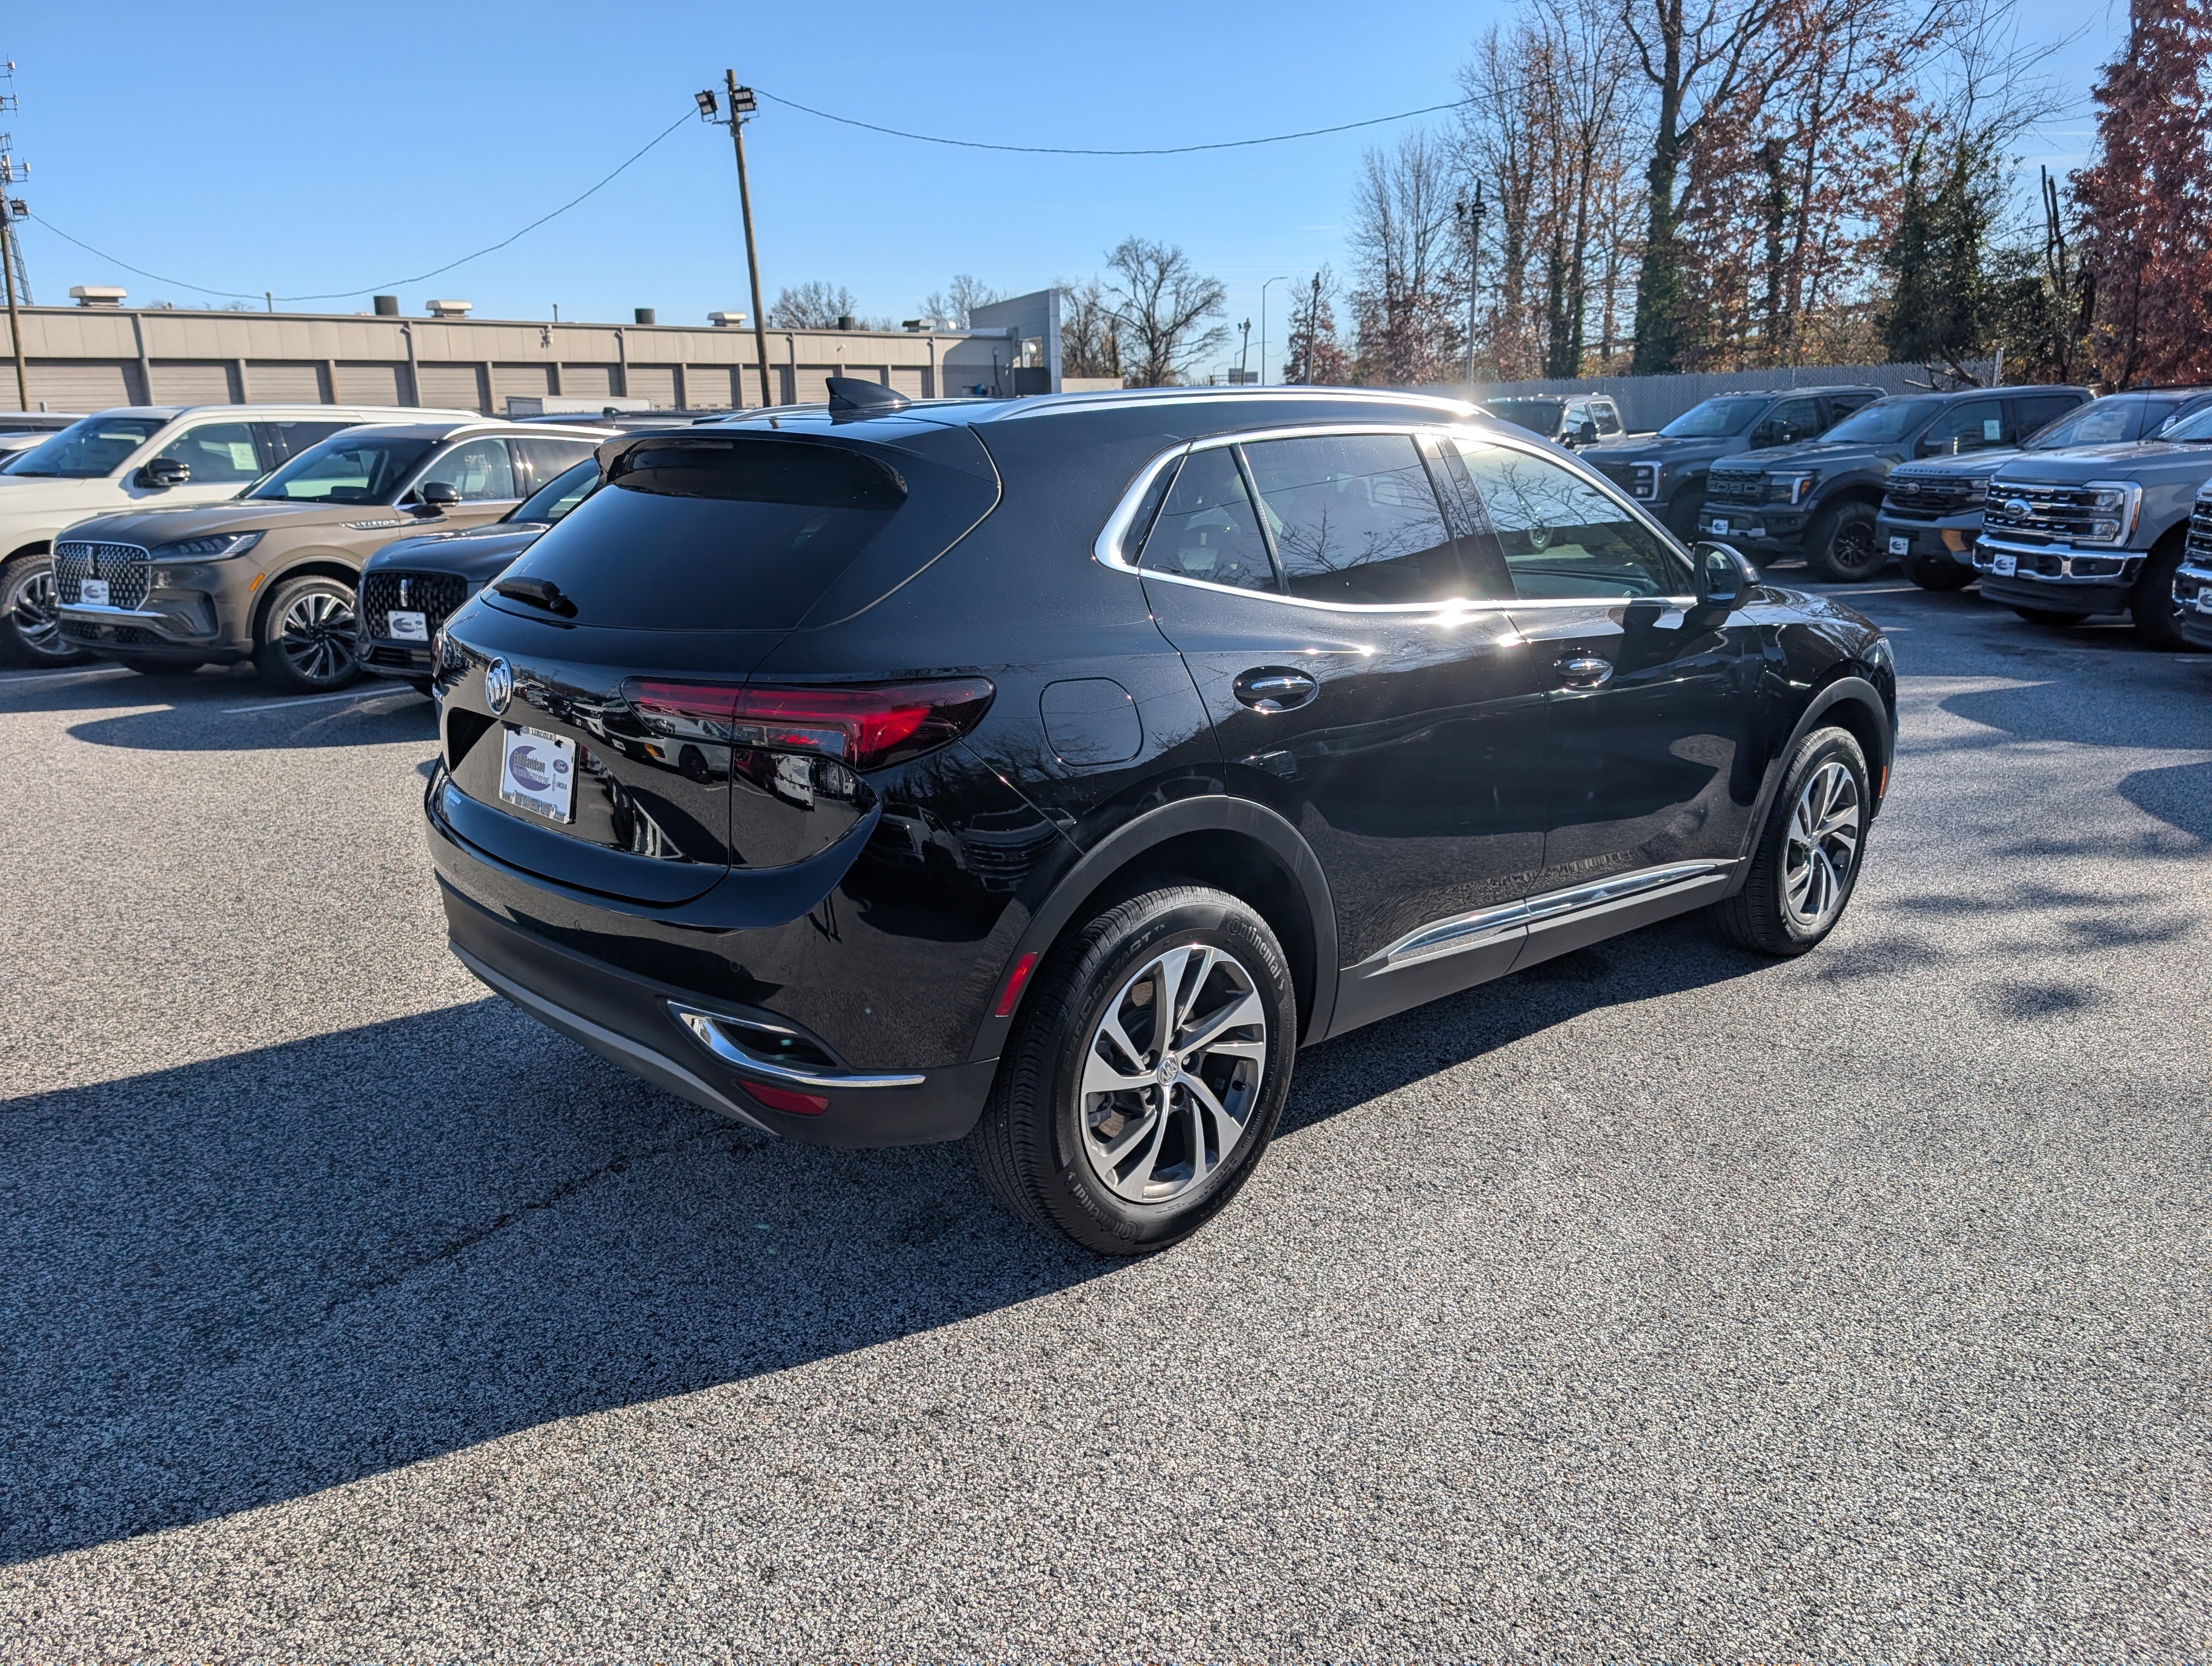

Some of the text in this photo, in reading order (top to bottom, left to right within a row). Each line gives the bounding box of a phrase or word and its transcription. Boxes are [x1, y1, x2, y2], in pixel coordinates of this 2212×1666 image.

[531, 728, 554, 741] LINCOLN
[514, 751, 545, 774] Bob Davidson
[1227, 913, 1282, 980] Continental
